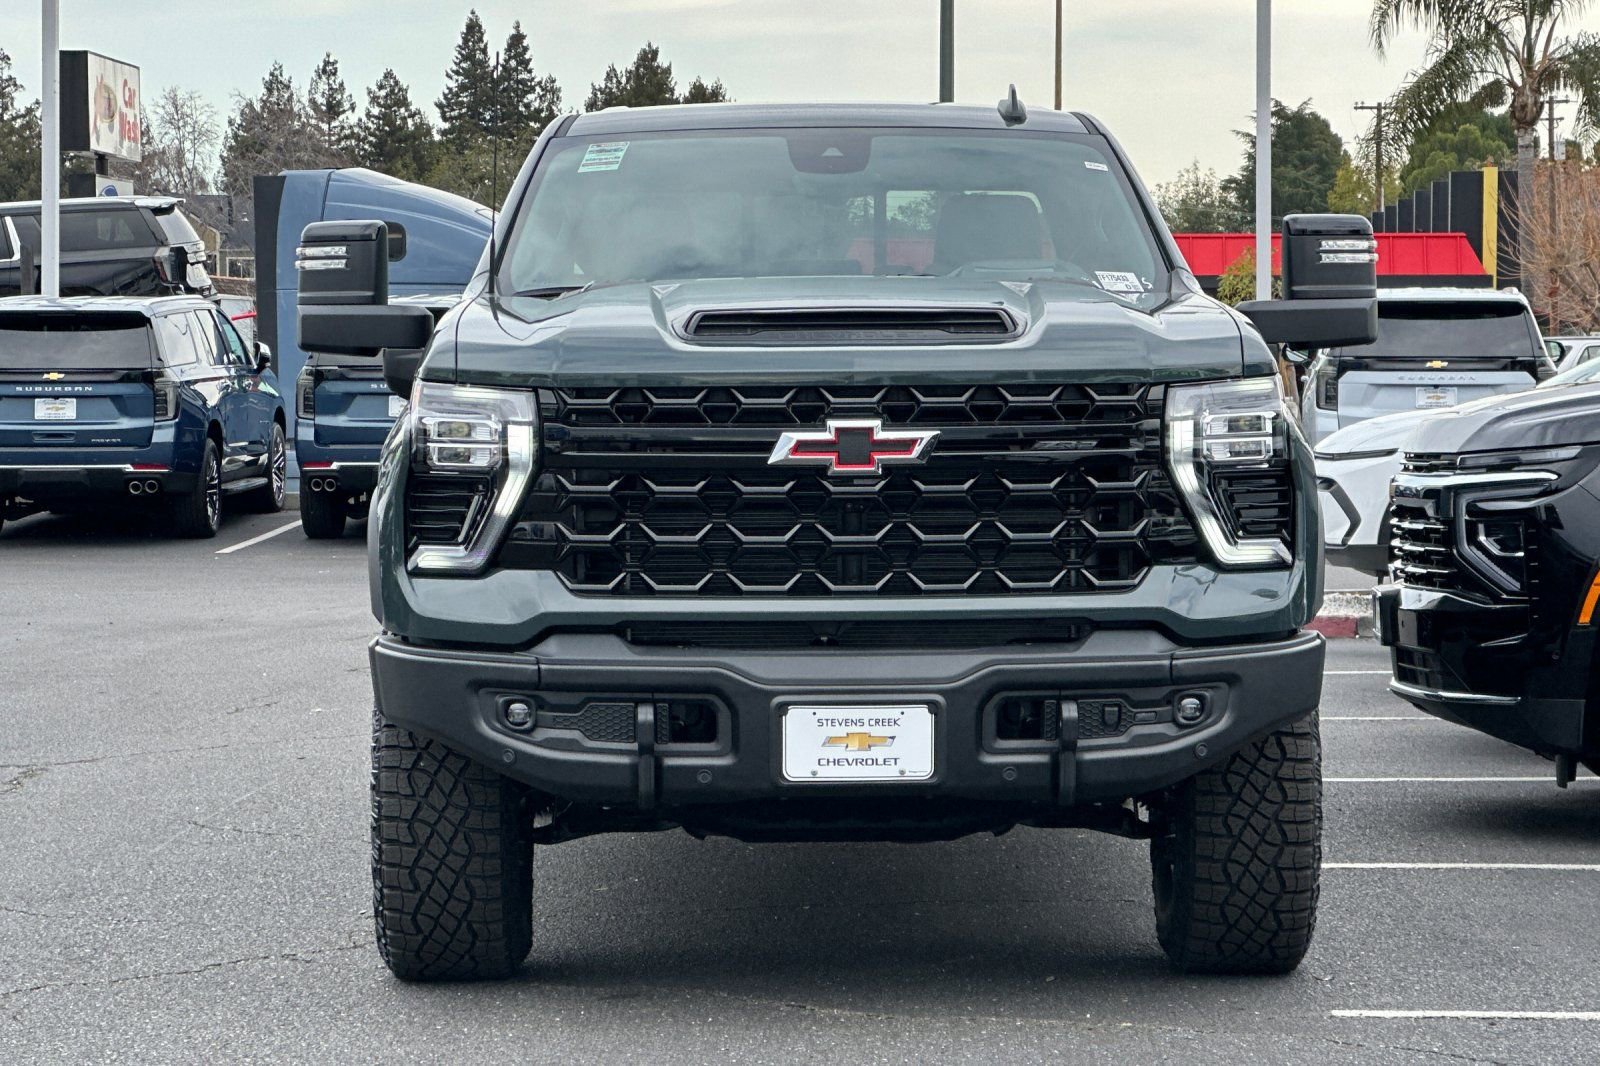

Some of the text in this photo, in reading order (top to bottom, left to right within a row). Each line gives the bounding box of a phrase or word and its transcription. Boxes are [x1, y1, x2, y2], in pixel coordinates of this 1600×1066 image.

[122, 78, 136, 110] Car
[118, 109, 140, 144] Wash
[816, 717, 901, 727] STEVENS CREEK
[817, 757, 900, 767] CHEVROLET
